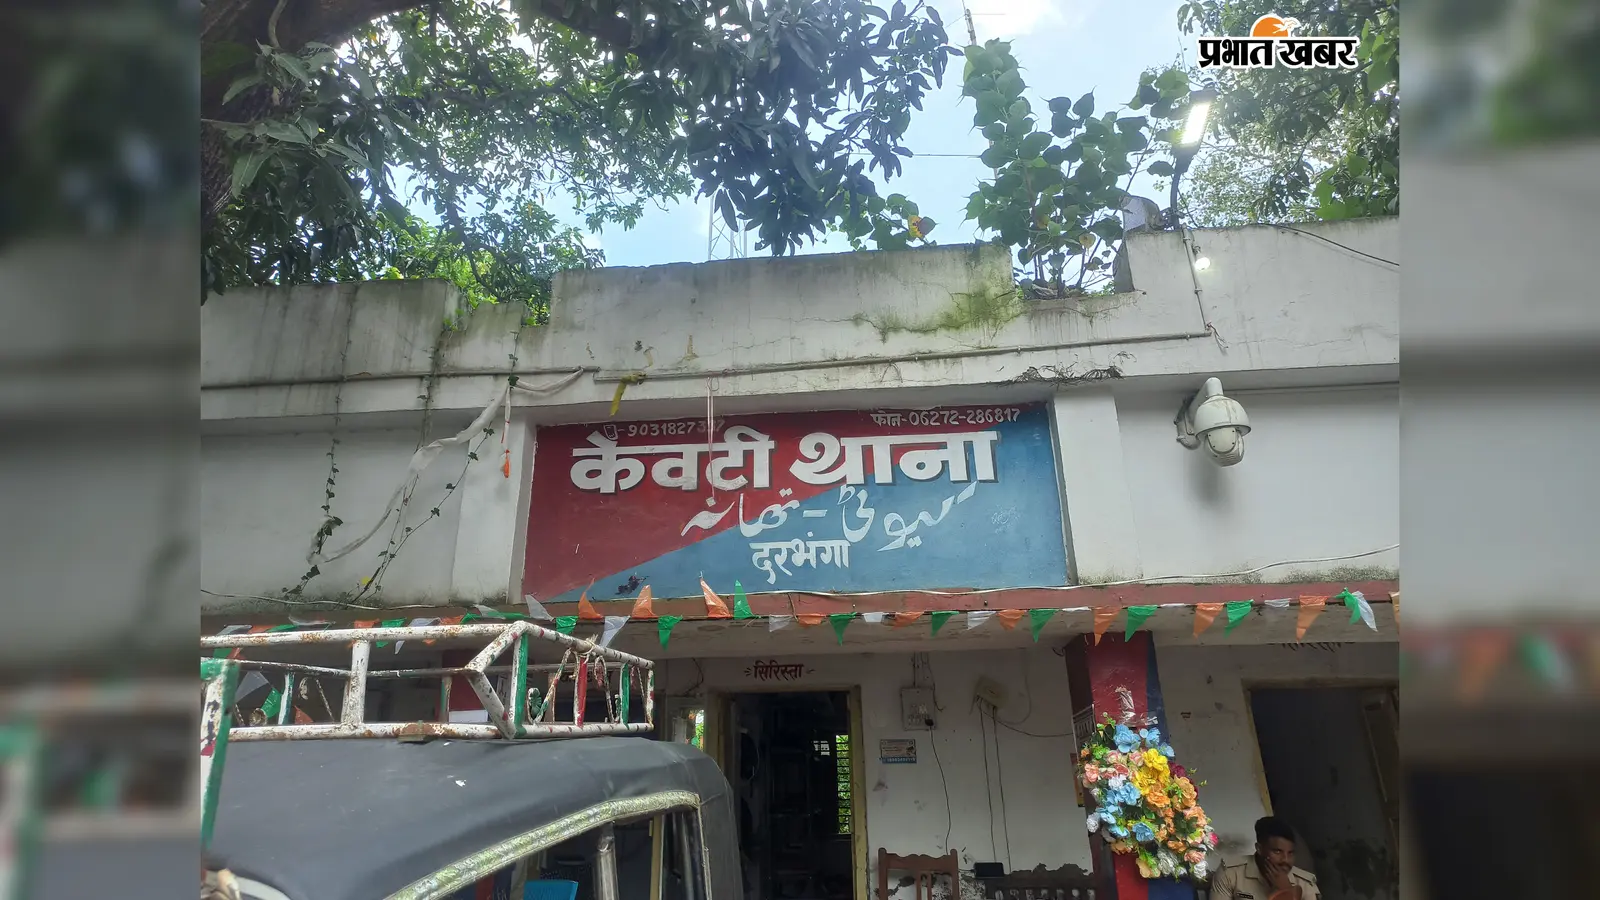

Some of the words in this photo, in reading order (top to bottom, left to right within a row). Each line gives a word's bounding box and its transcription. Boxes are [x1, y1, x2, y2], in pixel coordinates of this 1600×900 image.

[570, 425, 775, 493] केवटी
[789, 431, 998, 485] थाना
[749, 531, 851, 585] दरभंगा
